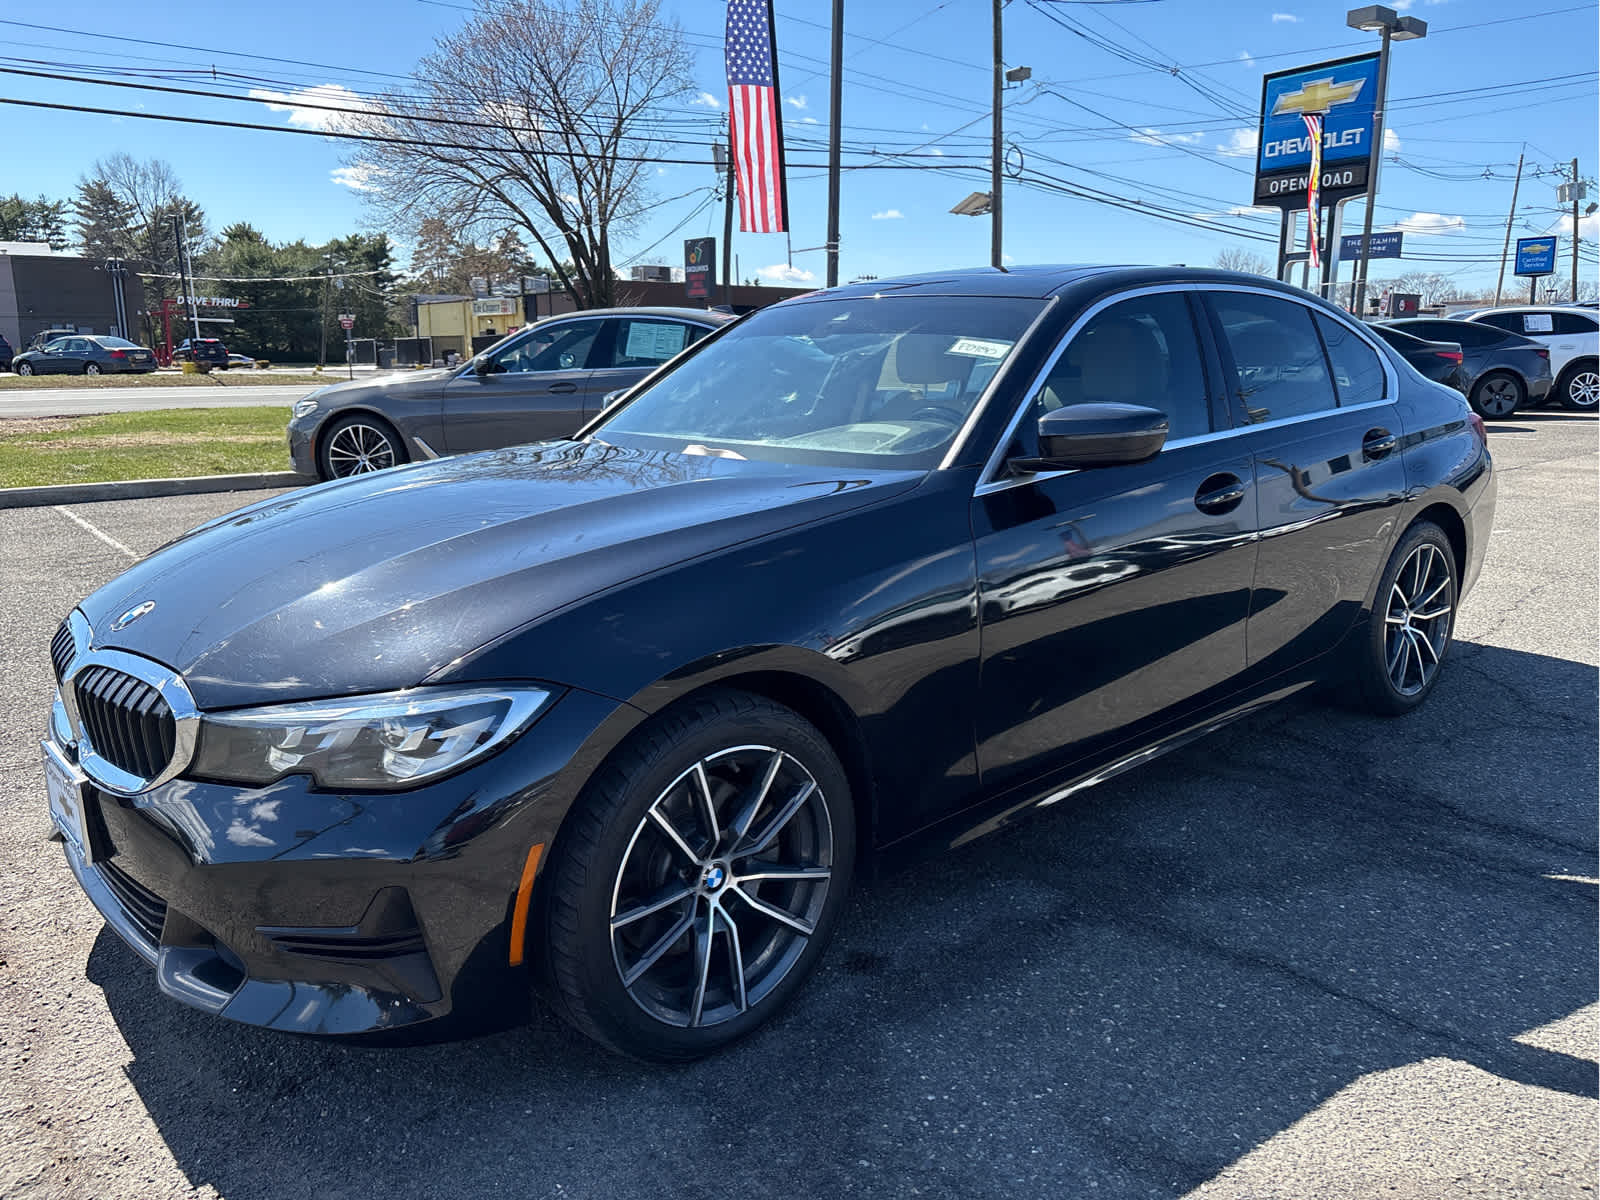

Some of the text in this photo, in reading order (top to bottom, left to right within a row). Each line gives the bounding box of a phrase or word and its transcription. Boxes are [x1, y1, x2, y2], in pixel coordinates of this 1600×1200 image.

[1265, 127, 1365, 158] CHEVOLET
[1269, 171, 1353, 194] OPEN OAD
[1369, 236, 1398, 245] ITAMIN
[177, 295, 240, 307] DRIVE THRU
